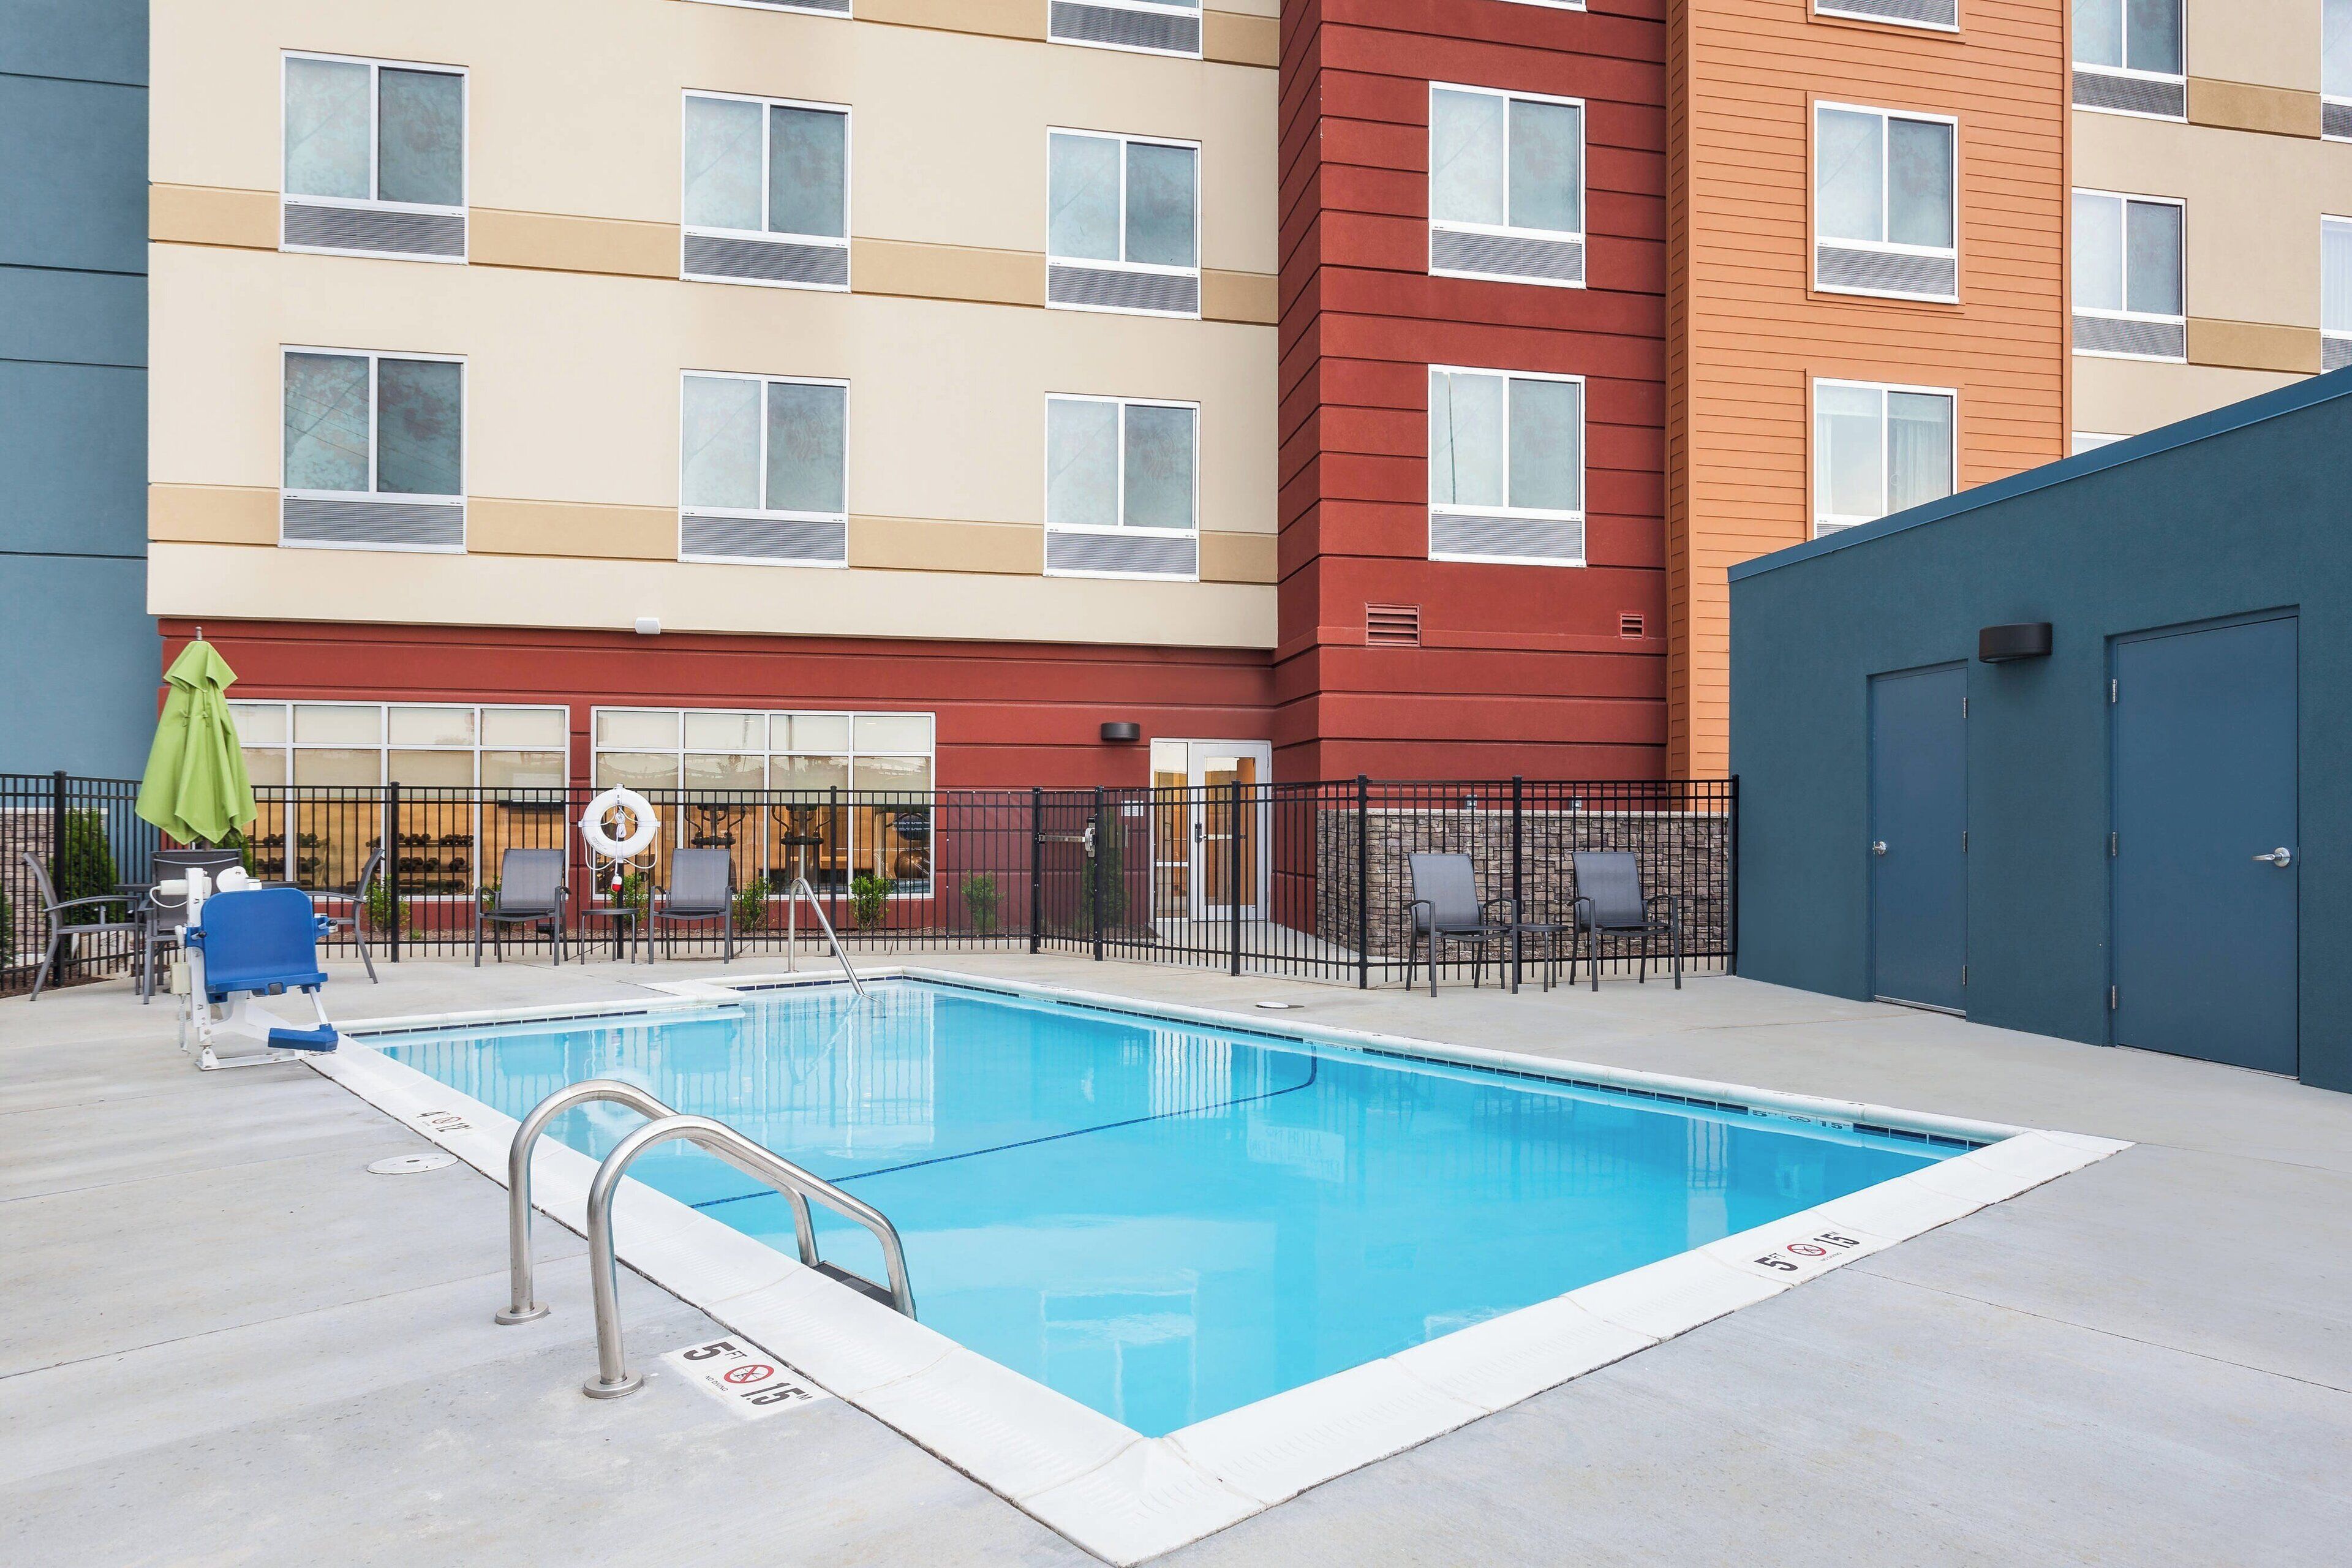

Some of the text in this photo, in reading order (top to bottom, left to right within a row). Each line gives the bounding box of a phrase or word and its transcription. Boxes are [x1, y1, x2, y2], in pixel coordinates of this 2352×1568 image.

[1813, 1234, 1860, 1248] 1.5
[1754, 1257, 1798, 1271] 5
[683, 1341, 748, 1360] 5 FT
[711, 1380, 728, 1392] DIVING
[741, 1382, 805, 1405] 1.5
